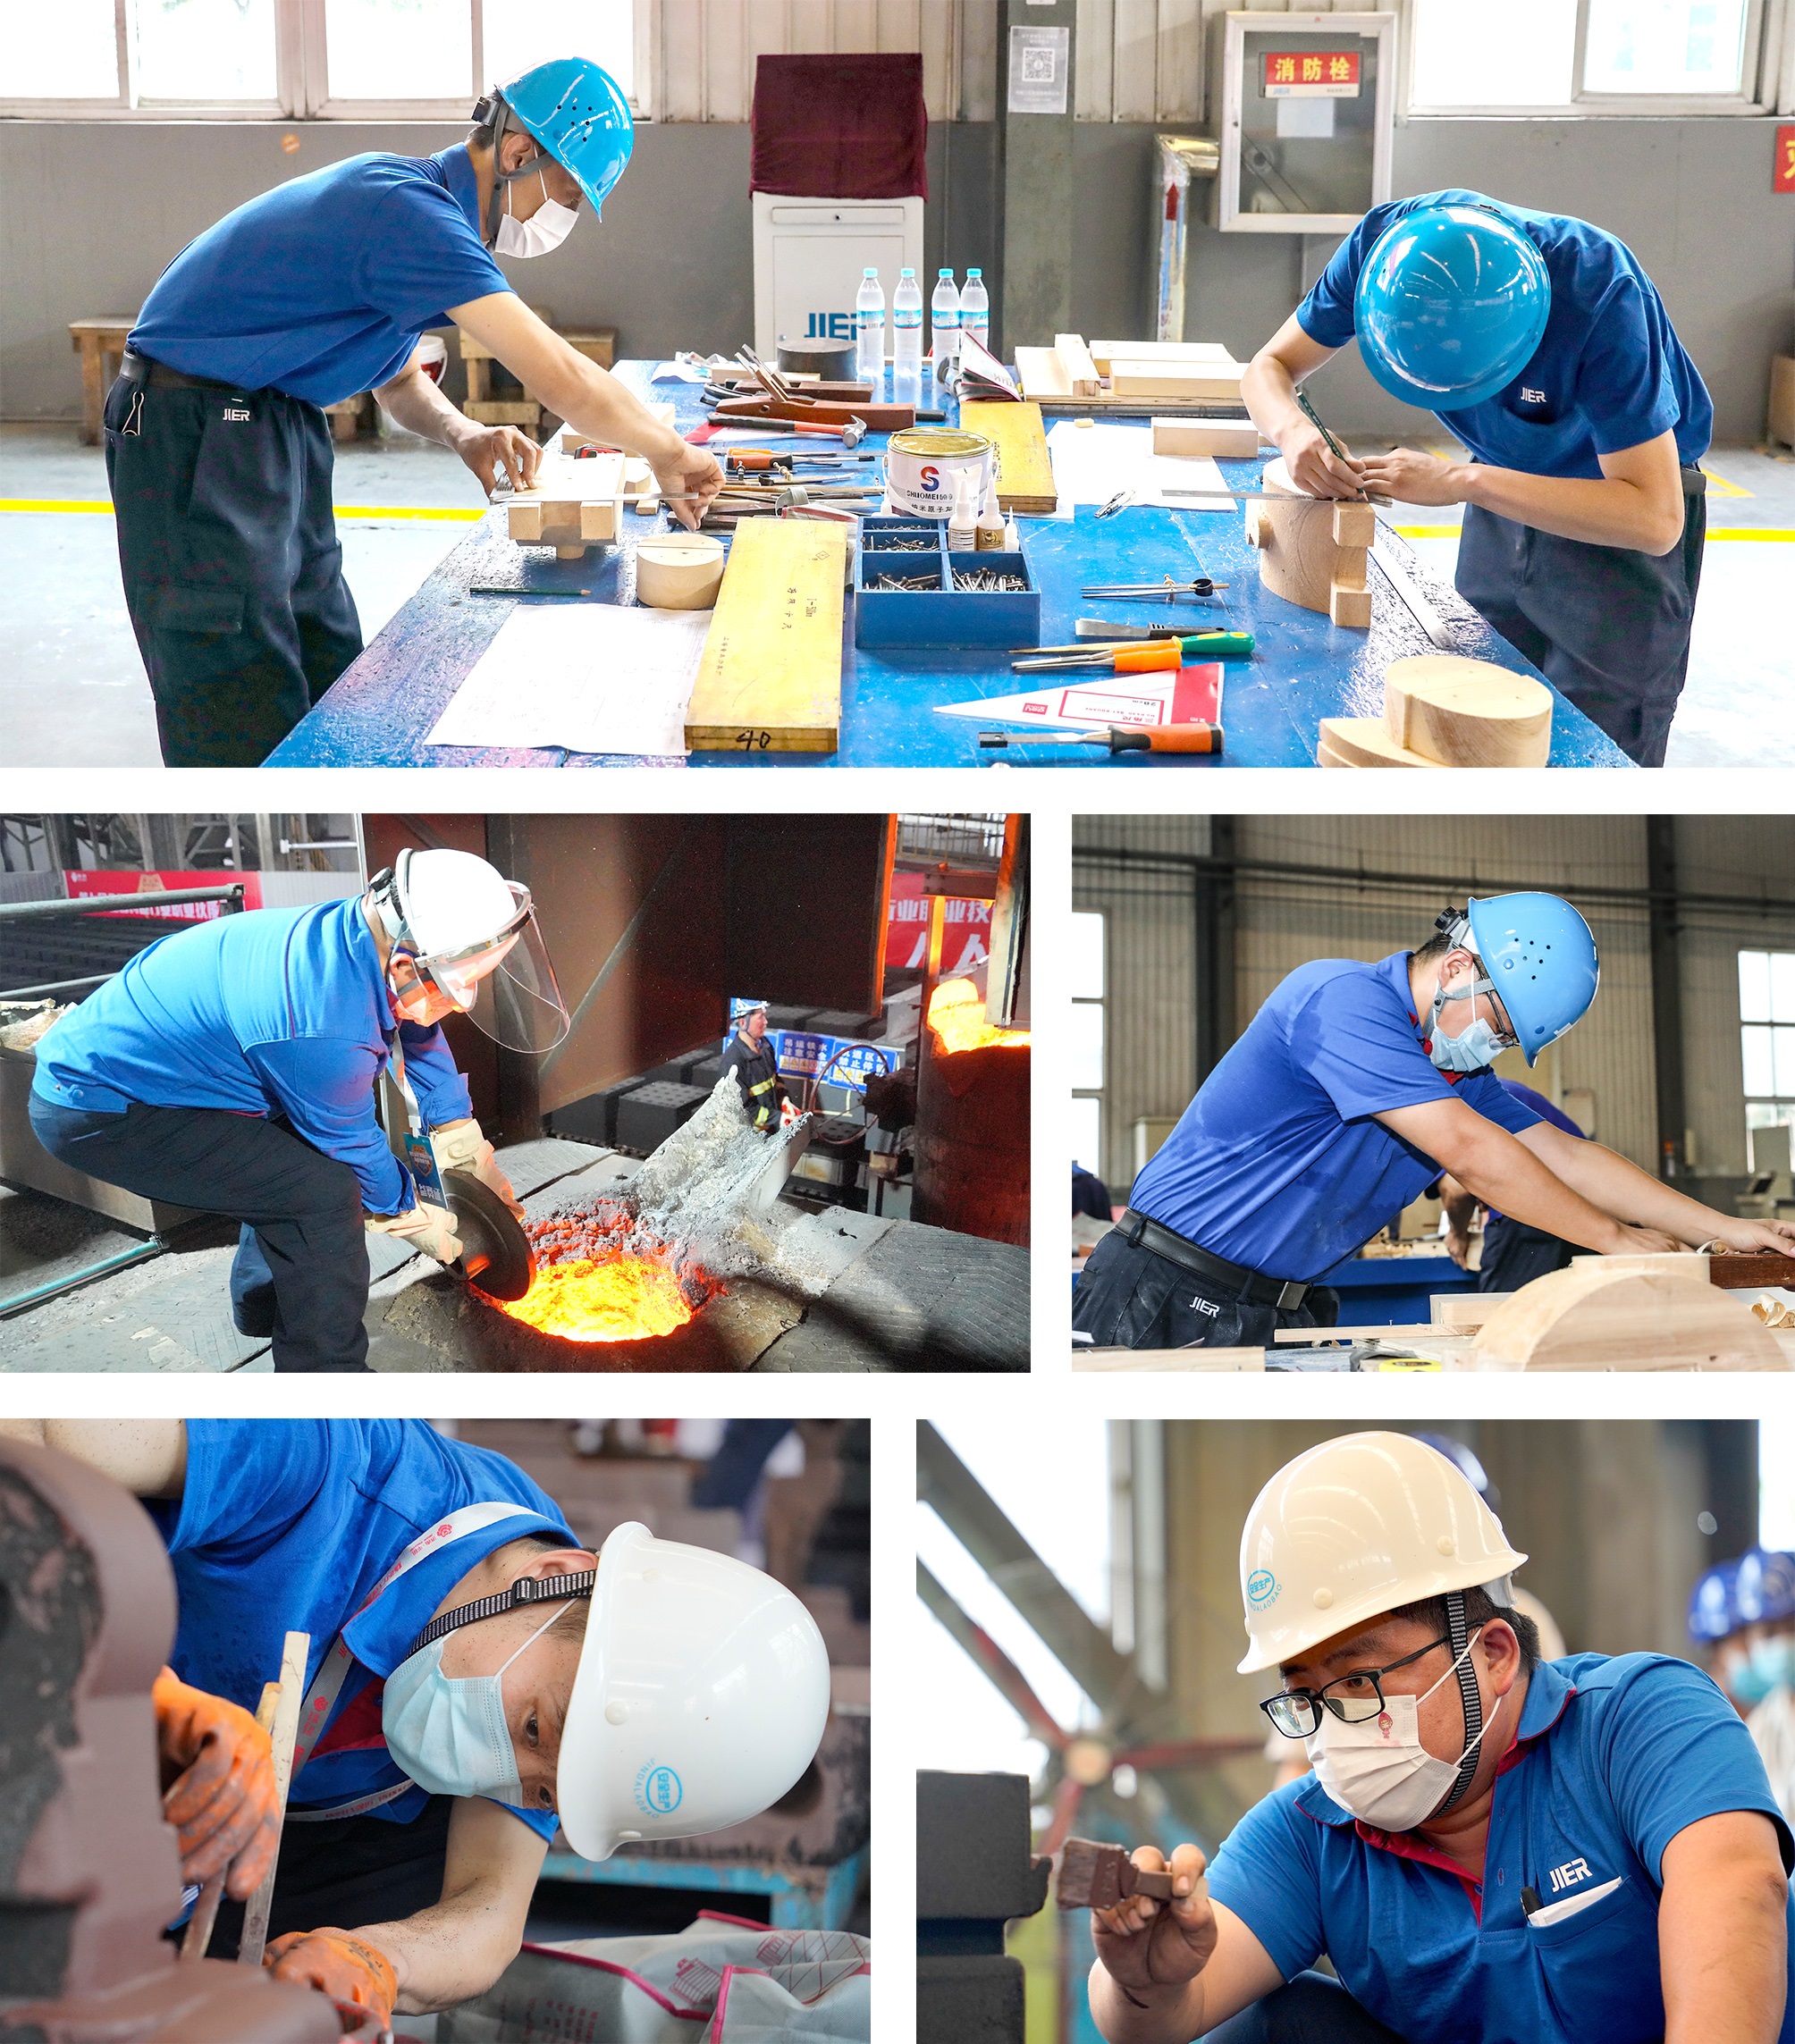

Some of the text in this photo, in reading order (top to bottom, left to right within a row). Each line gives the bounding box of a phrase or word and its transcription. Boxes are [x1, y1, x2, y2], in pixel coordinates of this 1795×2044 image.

[1275, 57, 1351, 81] 消防栓
[804, 313, 858, 340] JIE
[1521, 387, 1546, 402] JIER
[223, 408, 249, 421] JIER
[736, 730, 771, 751] 40
[1189, 1296, 1220, 1318] JIER
[1549, 1857, 1593, 1893] JIER
